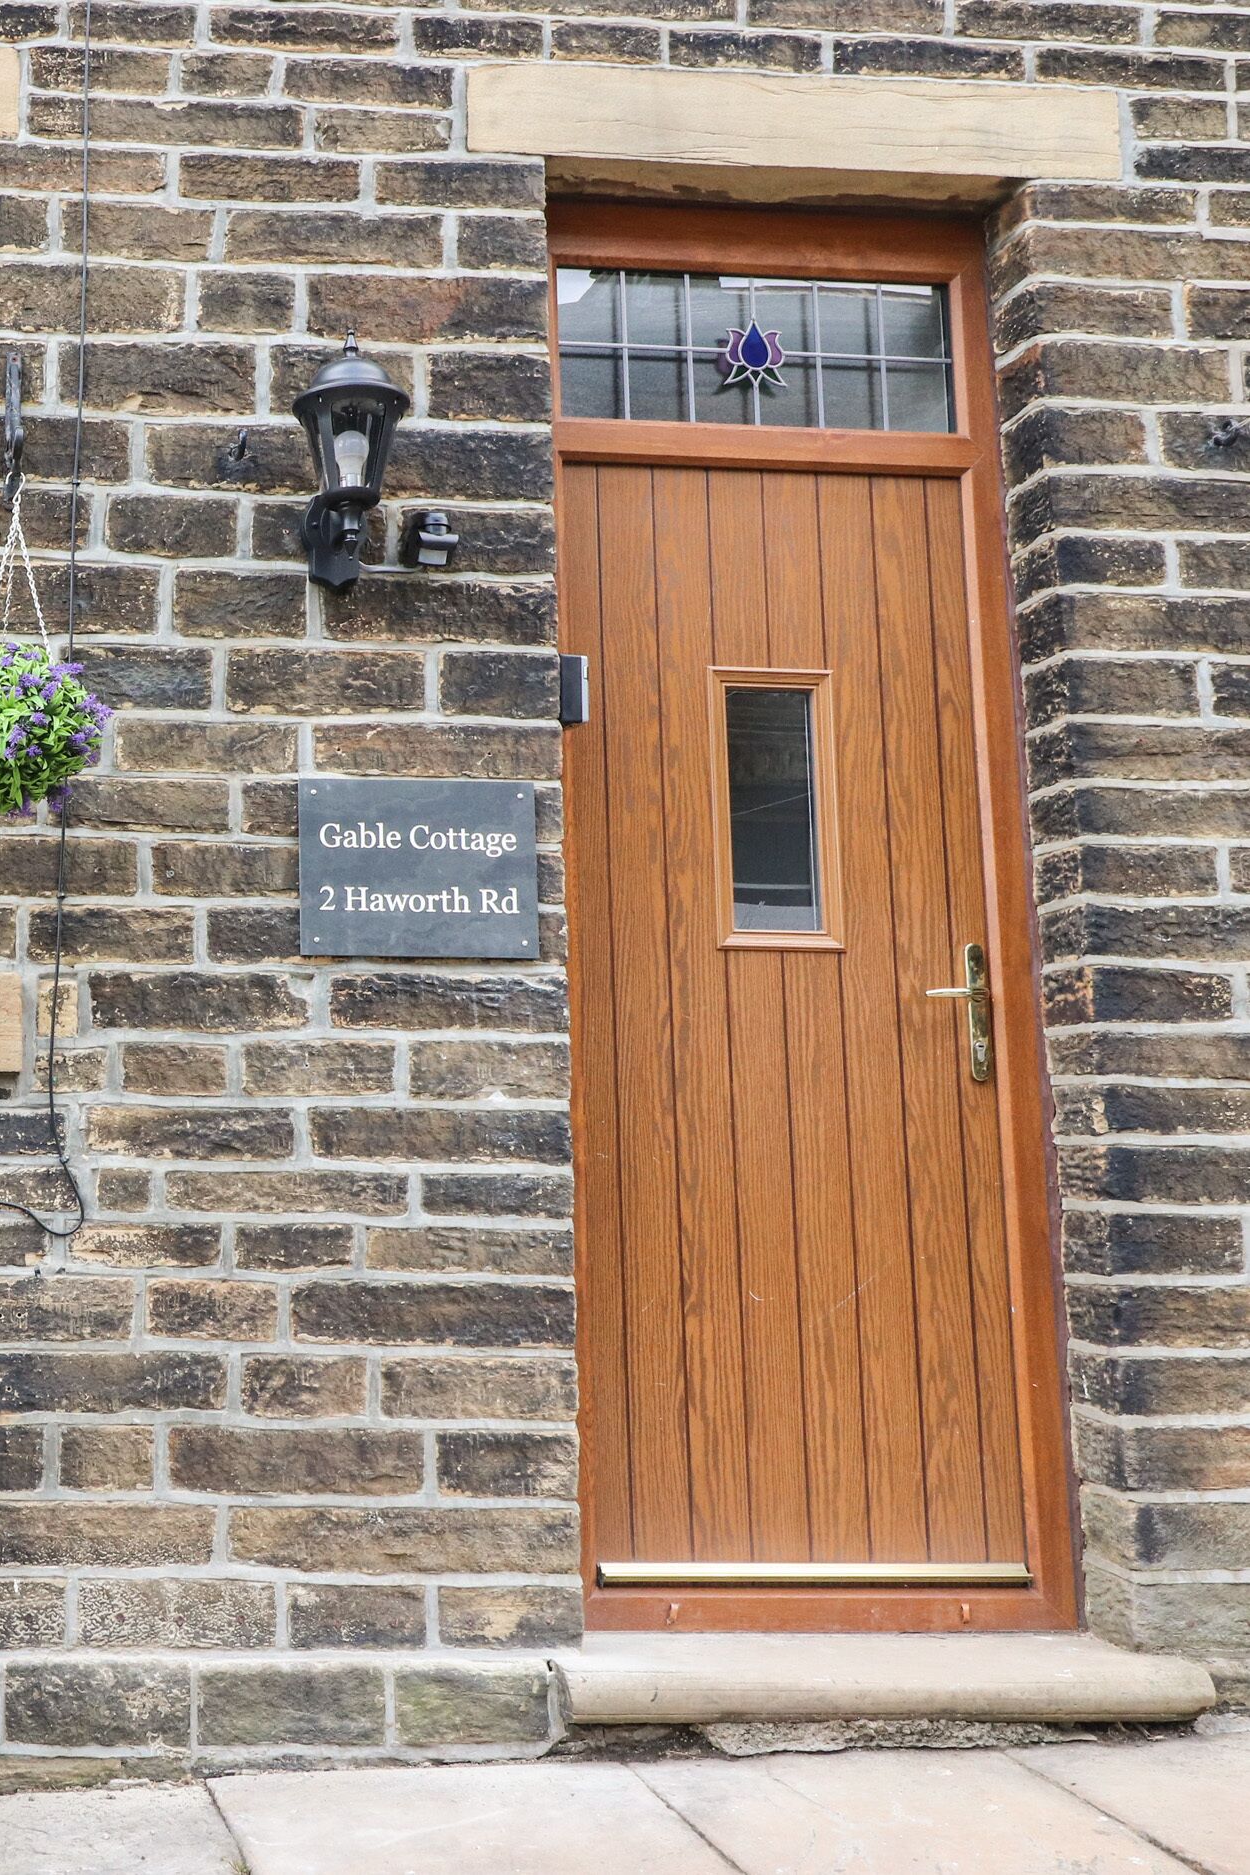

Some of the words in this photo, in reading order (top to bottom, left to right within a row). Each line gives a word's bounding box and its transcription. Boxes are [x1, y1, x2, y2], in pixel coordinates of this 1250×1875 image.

[319, 823, 402, 849] Gable
[409, 825, 517, 857] Cottage
[319, 886, 336, 911] 2
[344, 887, 471, 913] Haworth
[479, 888, 520, 914] Rd
